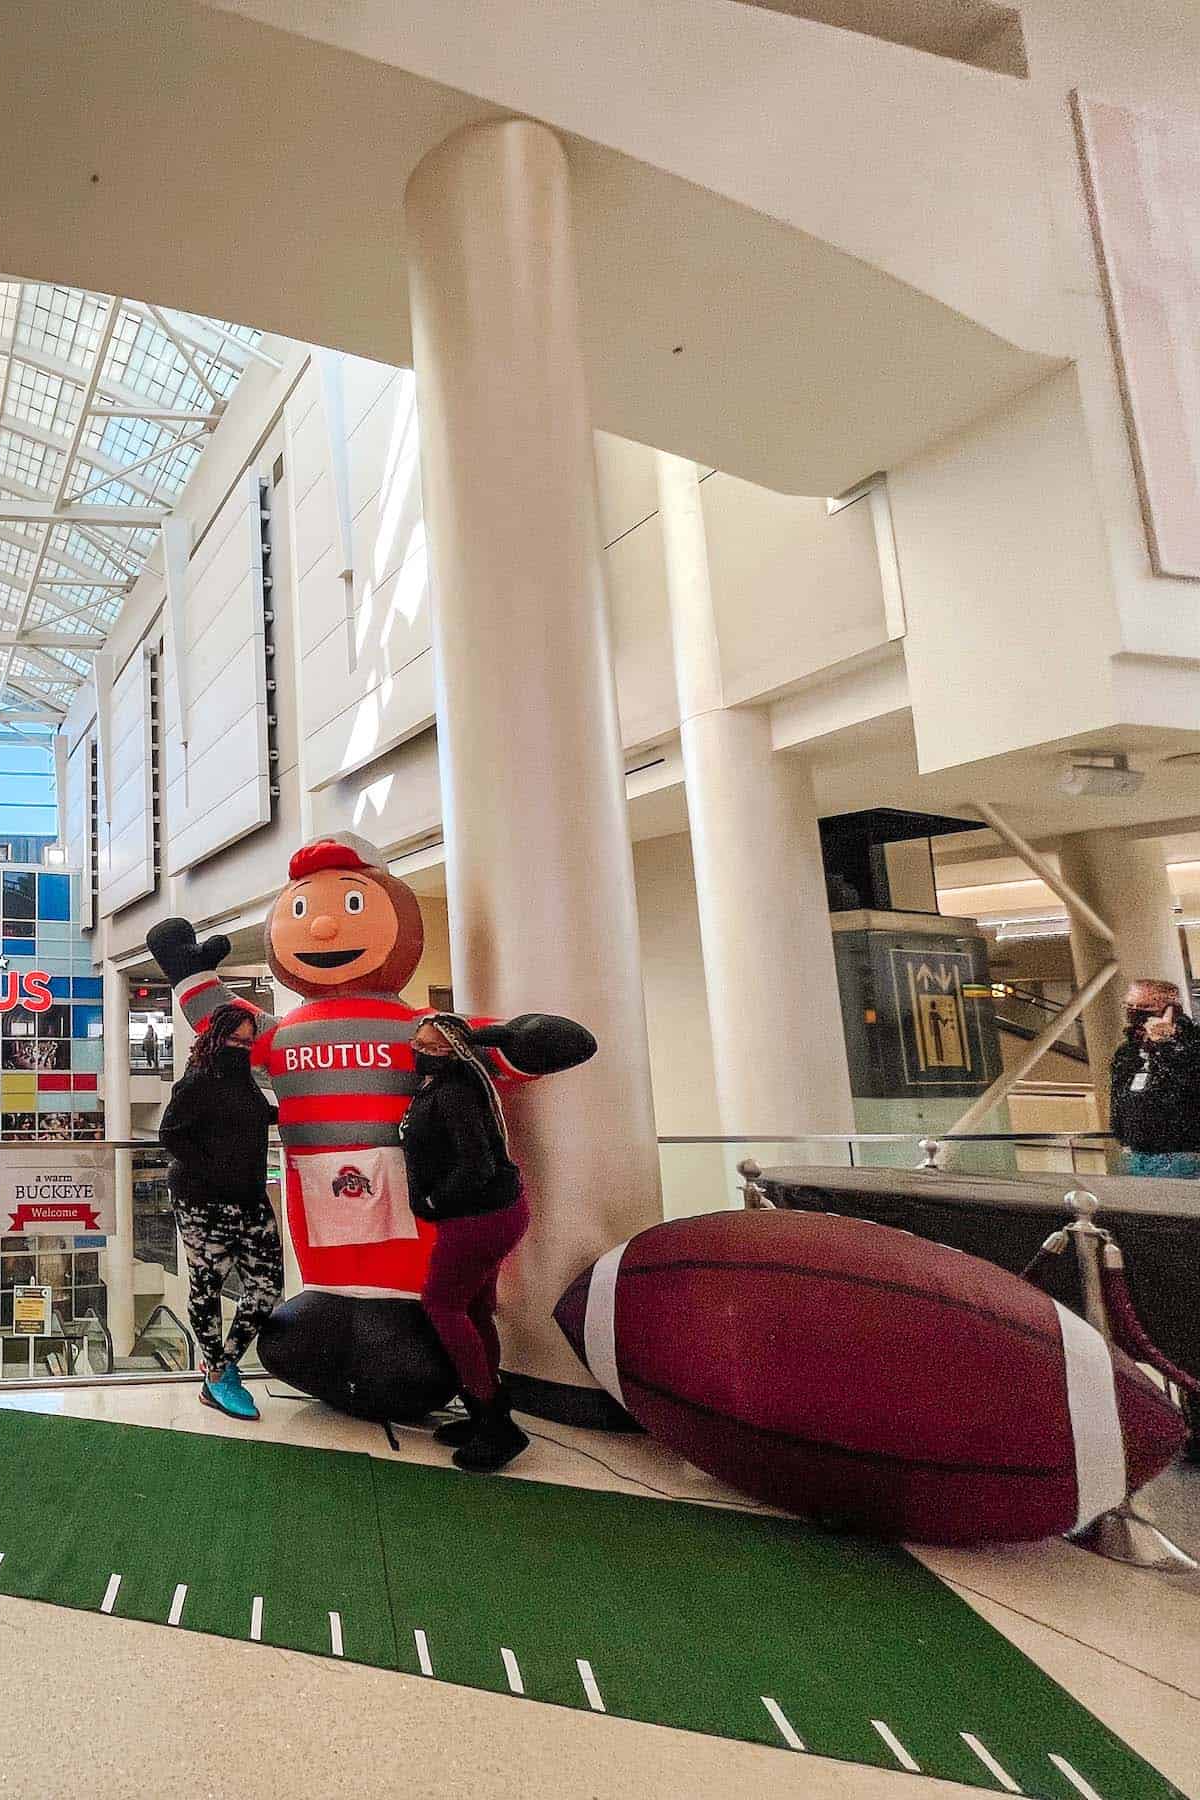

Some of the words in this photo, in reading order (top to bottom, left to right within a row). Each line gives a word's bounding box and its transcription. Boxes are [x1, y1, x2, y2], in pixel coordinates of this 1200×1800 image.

[286, 1043, 392, 1071] BRUTUS
[15, 1184, 94, 1199] BUCKEYE
[31, 1207, 78, 1218] Welcome
